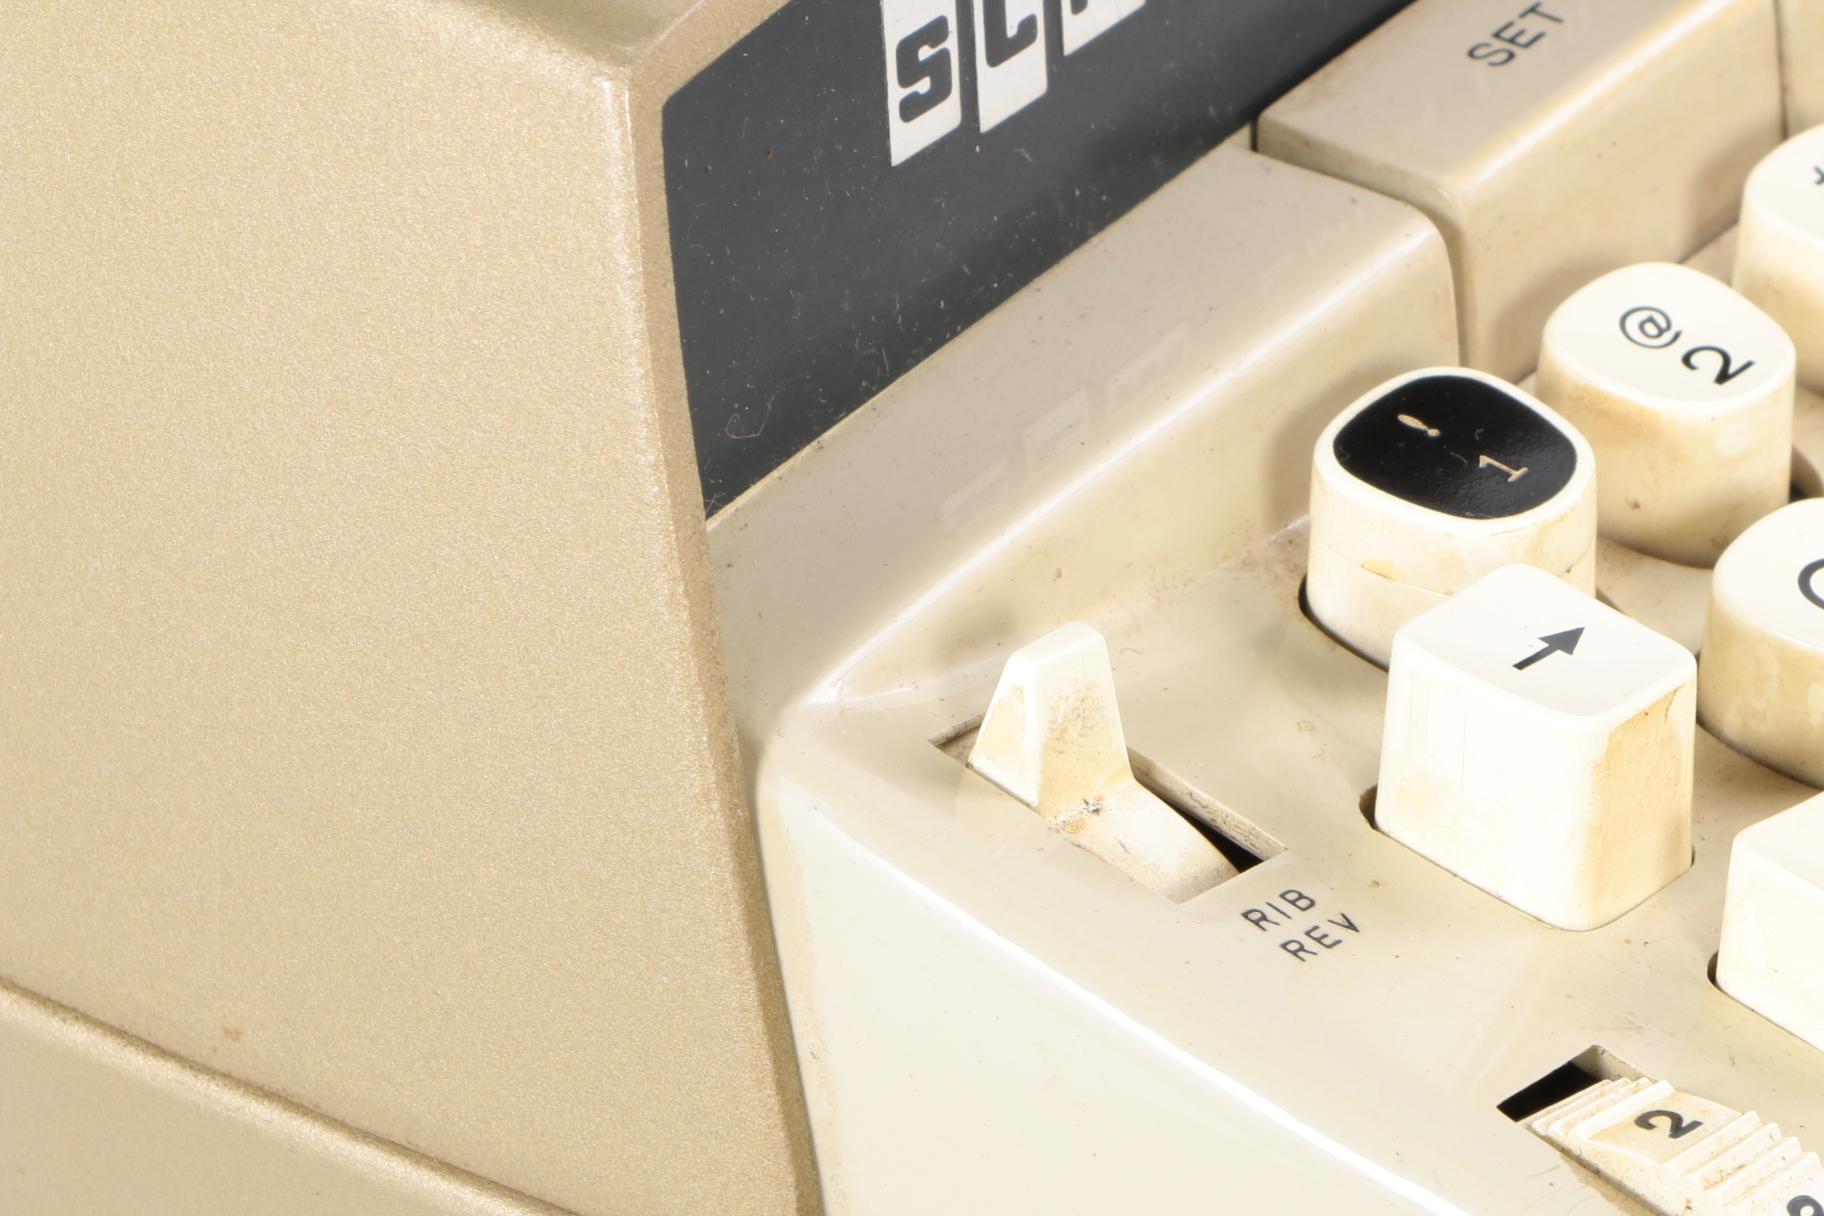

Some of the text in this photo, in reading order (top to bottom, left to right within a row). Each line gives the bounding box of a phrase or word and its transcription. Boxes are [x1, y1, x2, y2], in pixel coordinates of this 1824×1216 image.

[1466, 1, 1564, 67] SET
[1618, 306, 1683, 350] @
[1681, 345, 1755, 386] 2
[1396, 412, 1442, 439] !
[1477, 453, 1531, 484] 1
[1239, 887, 1318, 933] RIB
[1278, 910, 1363, 964] REV
[1633, 1109, 1704, 1140] 2
